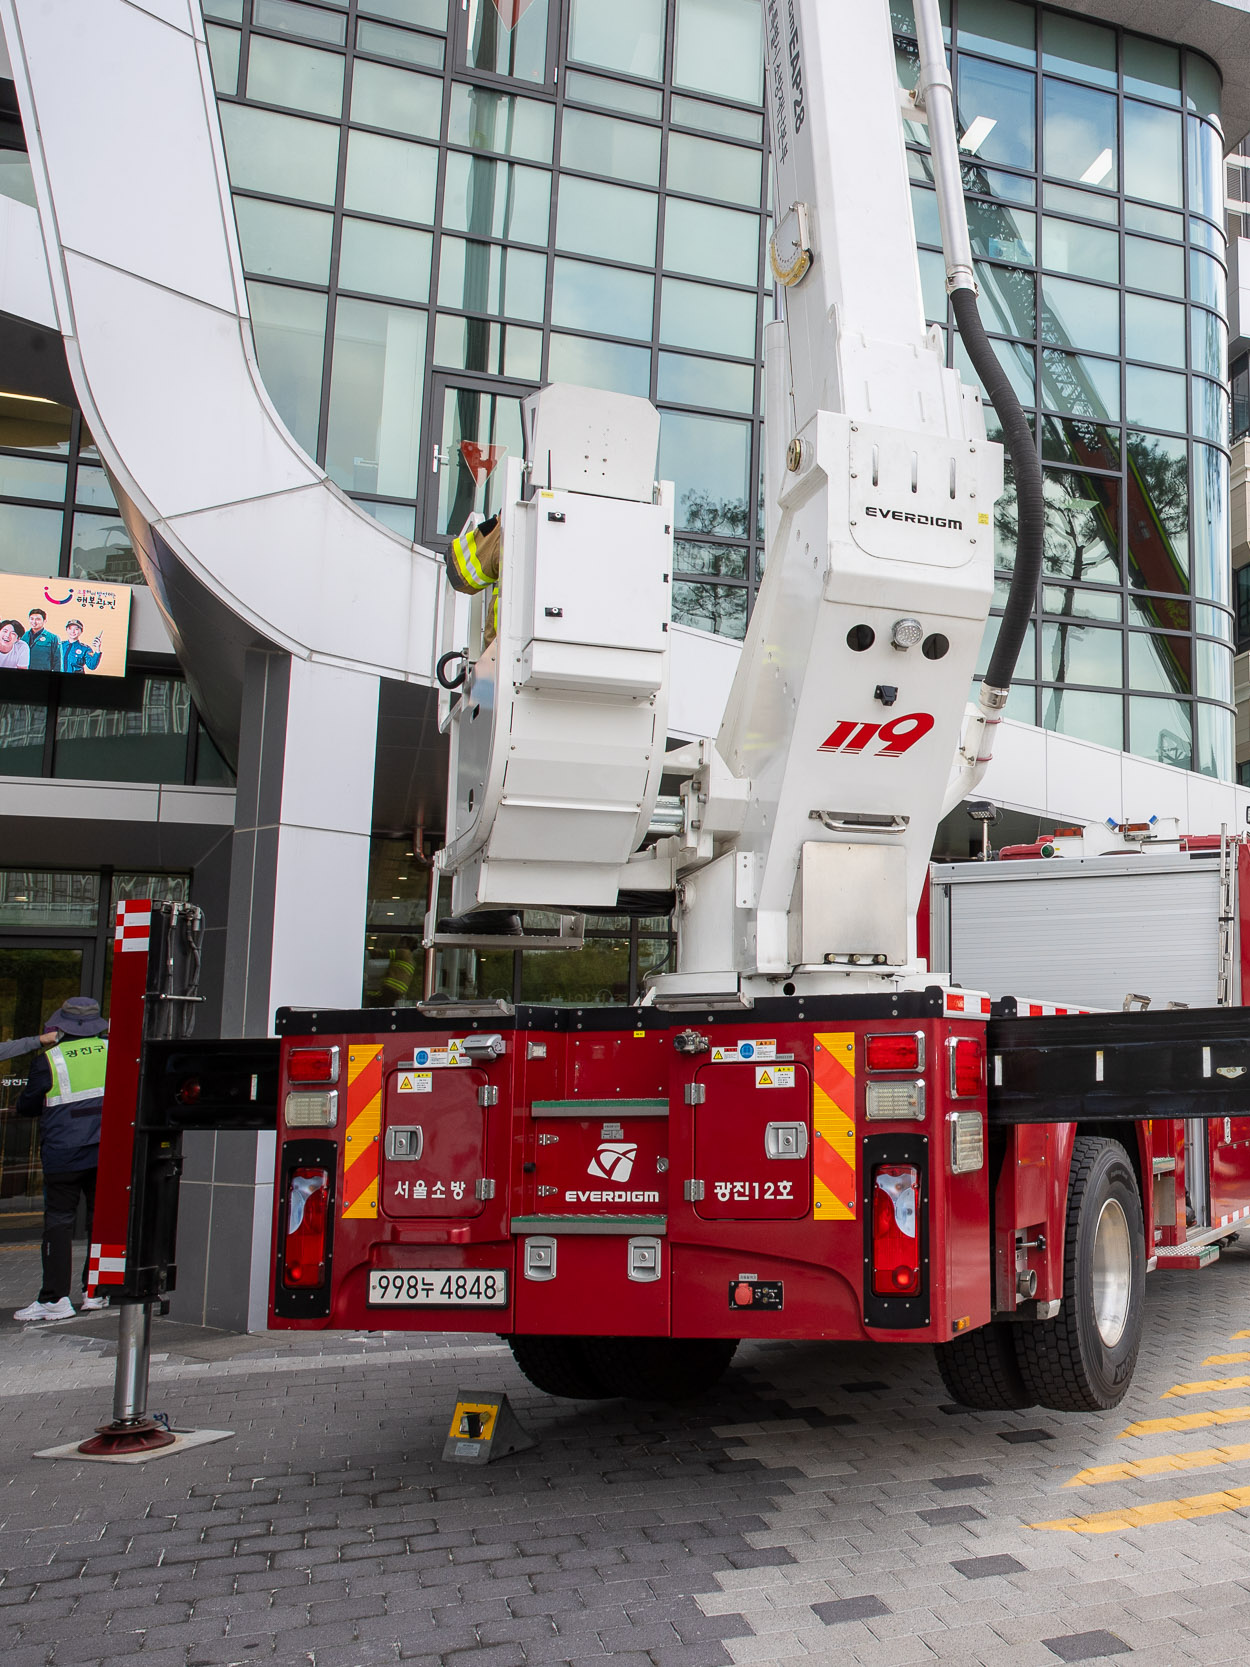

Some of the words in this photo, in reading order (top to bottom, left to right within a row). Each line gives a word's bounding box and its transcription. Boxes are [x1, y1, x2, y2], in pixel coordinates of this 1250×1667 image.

[788, 26, 805, 135] EAP28
[865, 506, 963, 530] EVERDIGM
[76, 595, 117, 610] 행복광진
[816, 712, 935, 758] 119
[65, 1045, 105, 1058] 광진구
[394, 1180, 466, 1200] 서울소방
[565, 1191, 660, 1203] EVERDIGM
[714, 1180, 794, 1202] 광진12호
[378, 1275, 434, 1299] 998누
[440, 1275, 497, 1300] 4848
